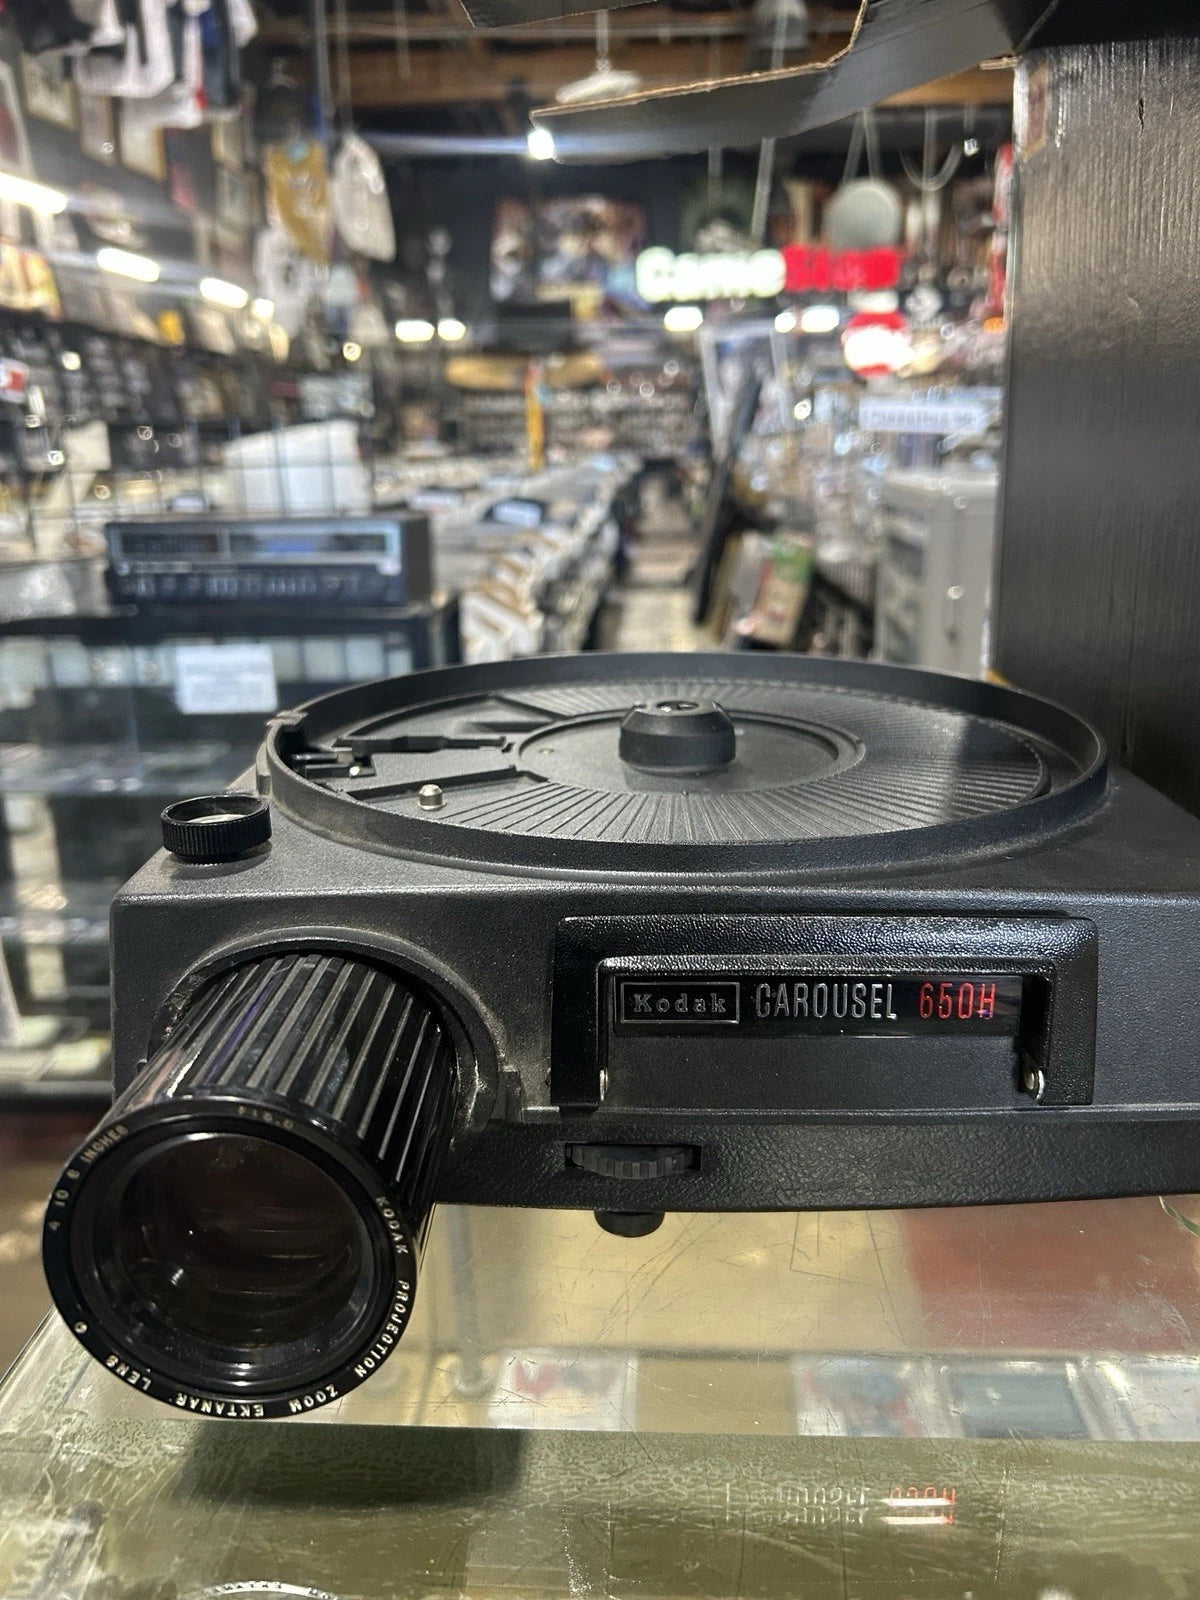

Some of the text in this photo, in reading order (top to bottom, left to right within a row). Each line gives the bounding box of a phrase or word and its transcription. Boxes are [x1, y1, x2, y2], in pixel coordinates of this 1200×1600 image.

[633, 992, 727, 1013] Kodak
[755, 982, 997, 1020] CAROUSEL 650H
[106, 1196, 410, 1417] KODAK PROJECTION ZOOM EKTANAR LENS
